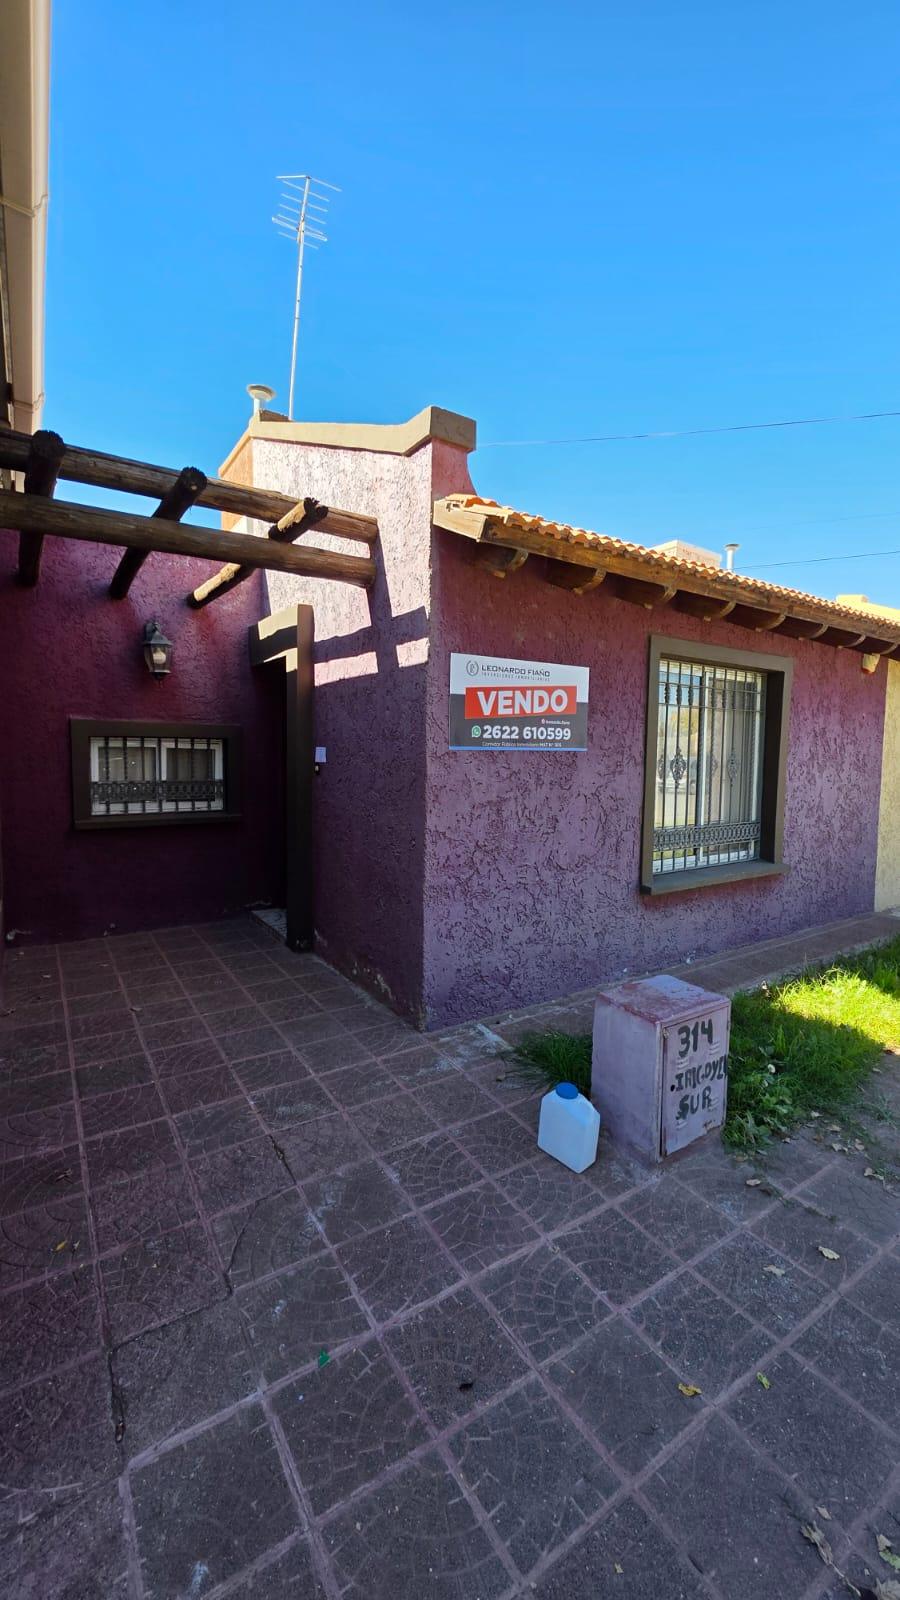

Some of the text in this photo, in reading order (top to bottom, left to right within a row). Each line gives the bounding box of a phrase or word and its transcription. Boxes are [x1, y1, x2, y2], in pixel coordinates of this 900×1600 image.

[481, 664, 526, 675] LEONARDO
[477, 689, 568, 716] VENDO
[482, 724, 571, 740] 2622 610599
[678, 1019, 713, 1058] 314
[676, 1086, 711, 1120] SUR
